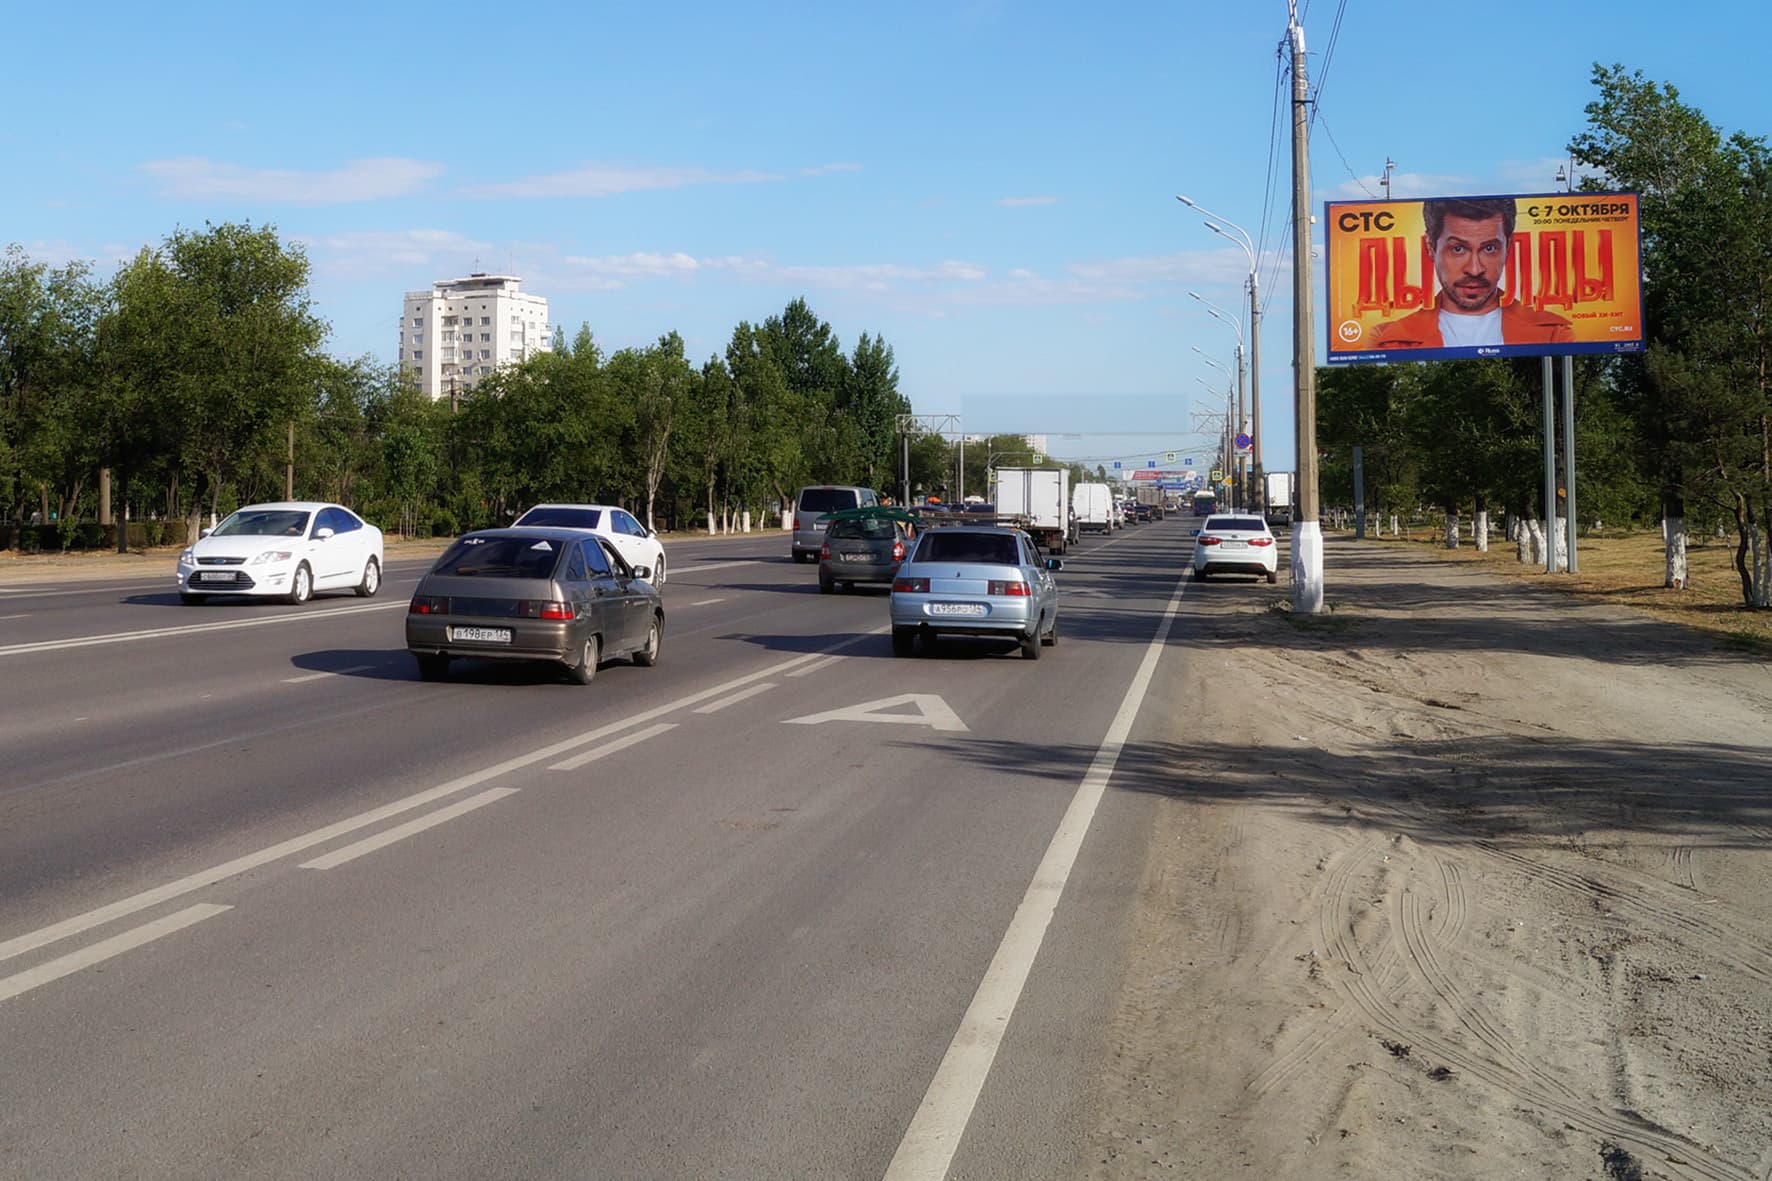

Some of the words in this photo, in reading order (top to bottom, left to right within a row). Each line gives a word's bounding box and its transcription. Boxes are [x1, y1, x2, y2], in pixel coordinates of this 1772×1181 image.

[1527, 206, 1540, 217] С
[1544, 206, 1553, 217] 7
[1558, 203, 1630, 216] ОКТЯБРЯ
[1338, 211, 1394, 233] СТС
